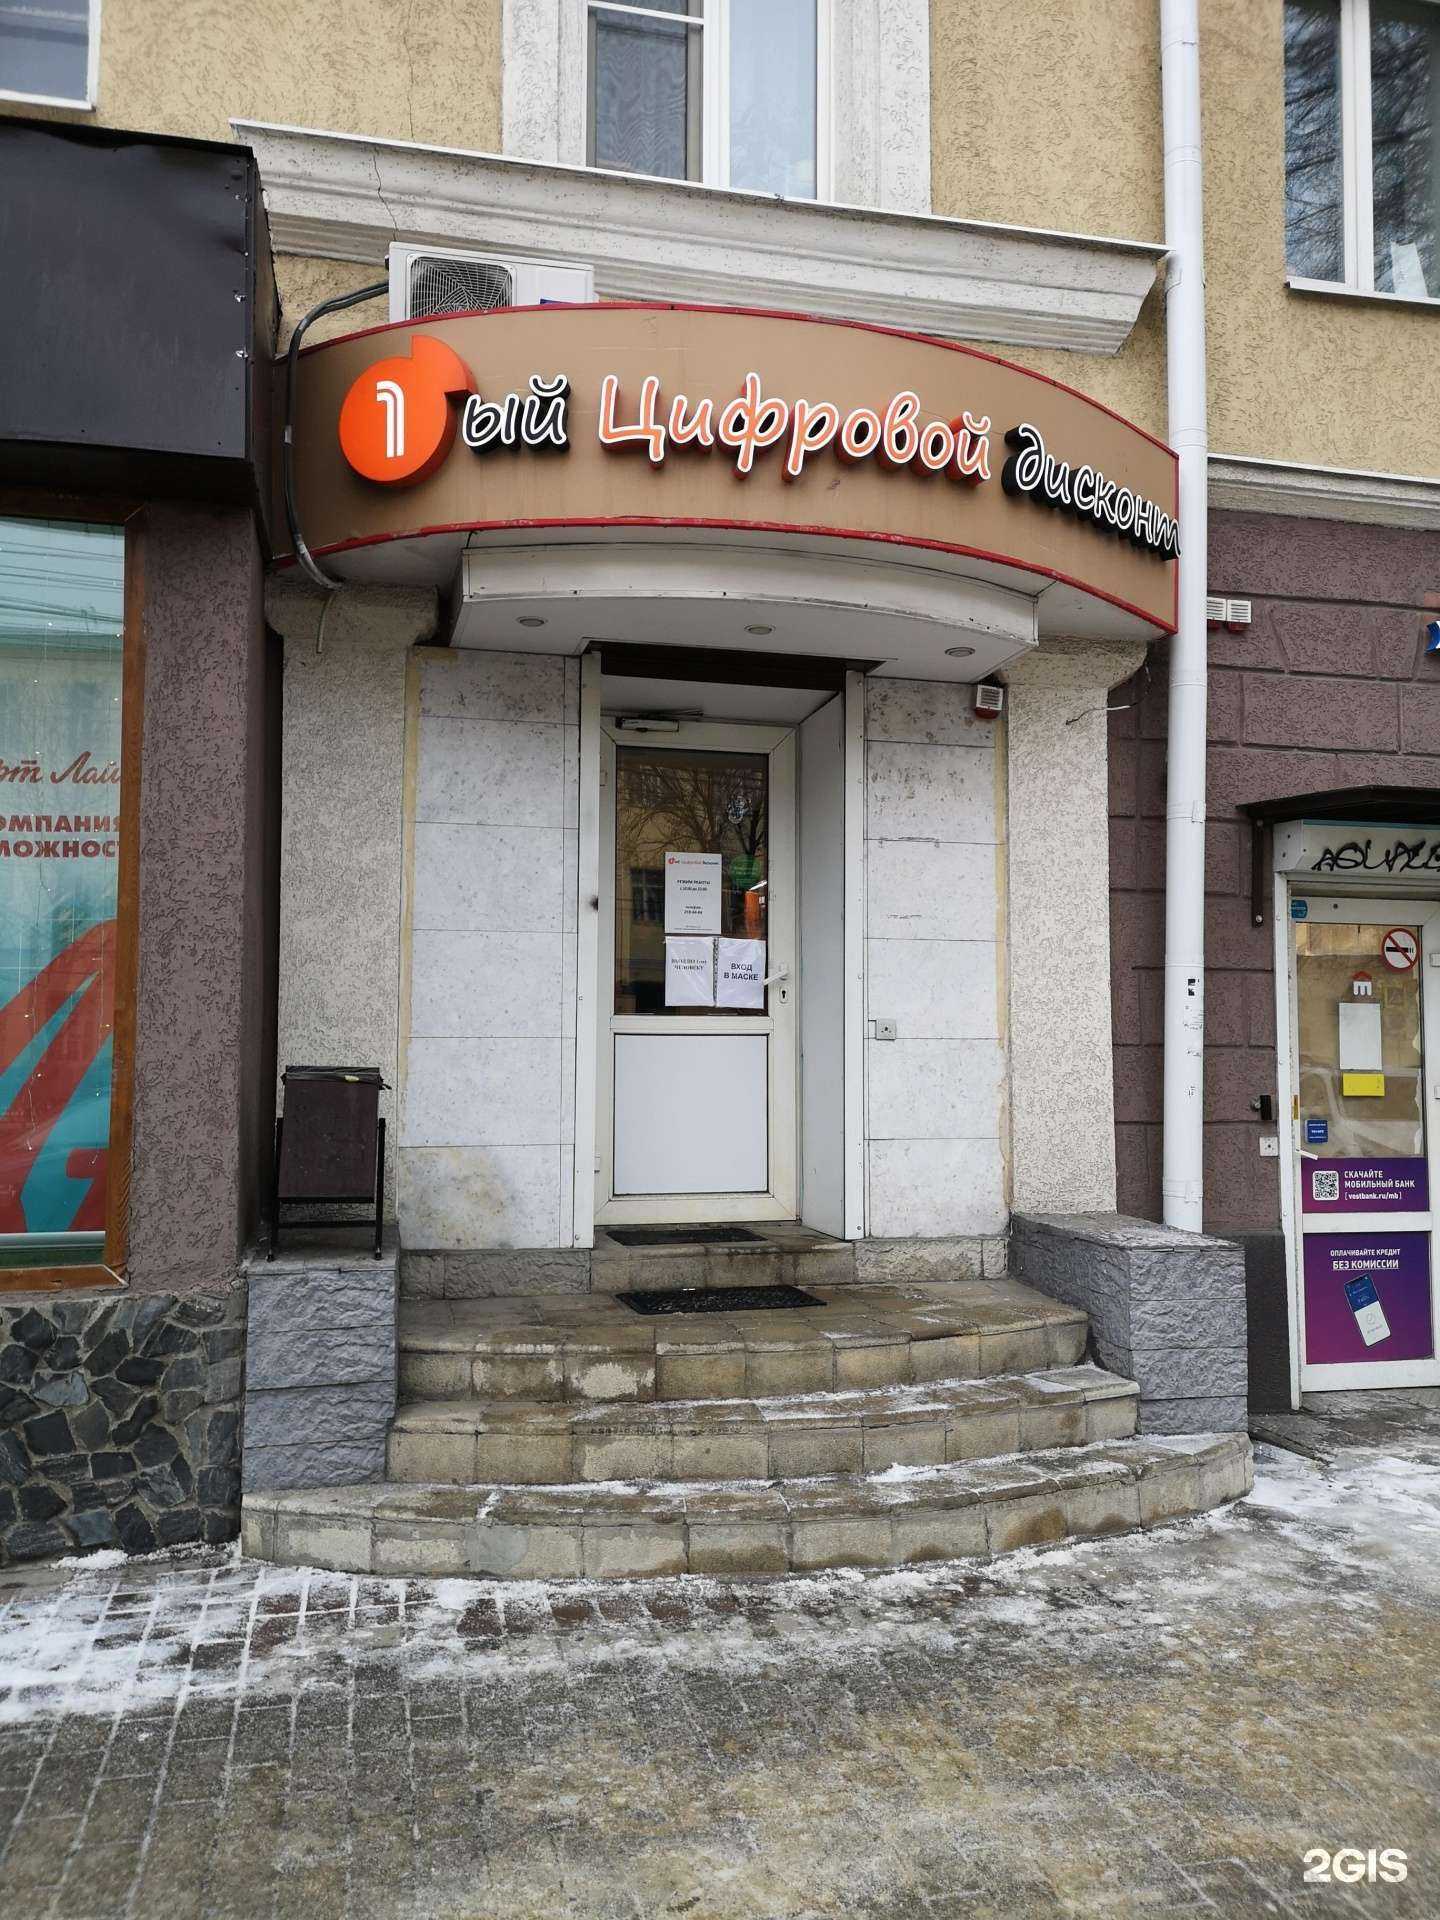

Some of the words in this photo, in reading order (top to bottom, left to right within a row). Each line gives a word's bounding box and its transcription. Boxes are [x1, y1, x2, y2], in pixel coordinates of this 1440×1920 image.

[599, 371, 992, 482] Цифровой
[730, 962, 753, 971] ВХОД
[731, 973, 759, 981] МАСКЕ
[1344, 1169, 1384, 1179] СКАЧАЙТЕ
[1344, 1179, 1394, 1189] МОБИЛЬНЫЙ
[1394, 1180, 1416, 1188] БАНК
[1330, 1248, 1376, 1257] ОПЛАЧИВАЙТЕ
[1376, 1248, 1401, 1256] КРЕДИТ
[1332, 1260, 1350, 1269] БЕЗ
[1351, 1259, 1399, 1269] КОМИССИИ
